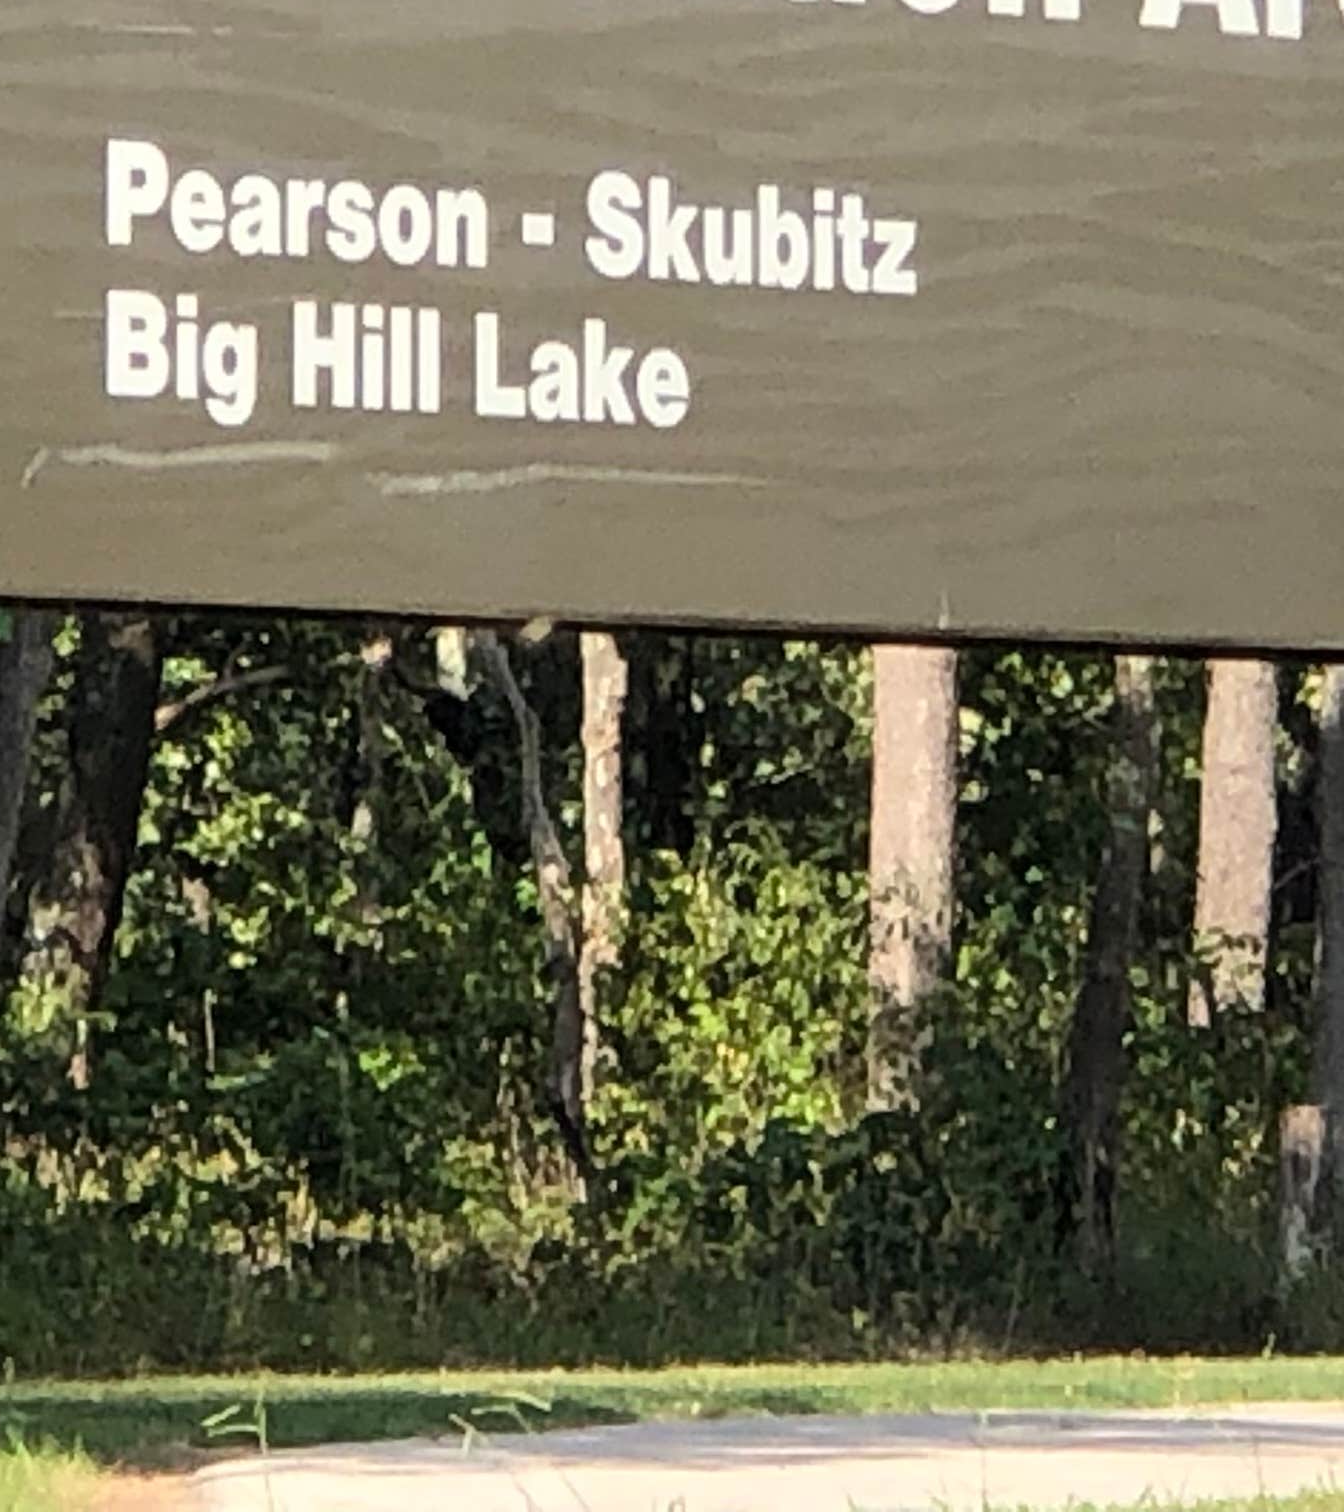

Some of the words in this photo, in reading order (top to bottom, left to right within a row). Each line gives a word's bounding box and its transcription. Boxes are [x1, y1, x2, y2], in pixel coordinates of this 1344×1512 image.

[106, 138, 489, 269] Pearson
[585, 169, 918, 296] Skubitz
[106, 289, 258, 426] Big
[293, 300, 441, 414] Hill
[474, 312, 691, 428] Lake
